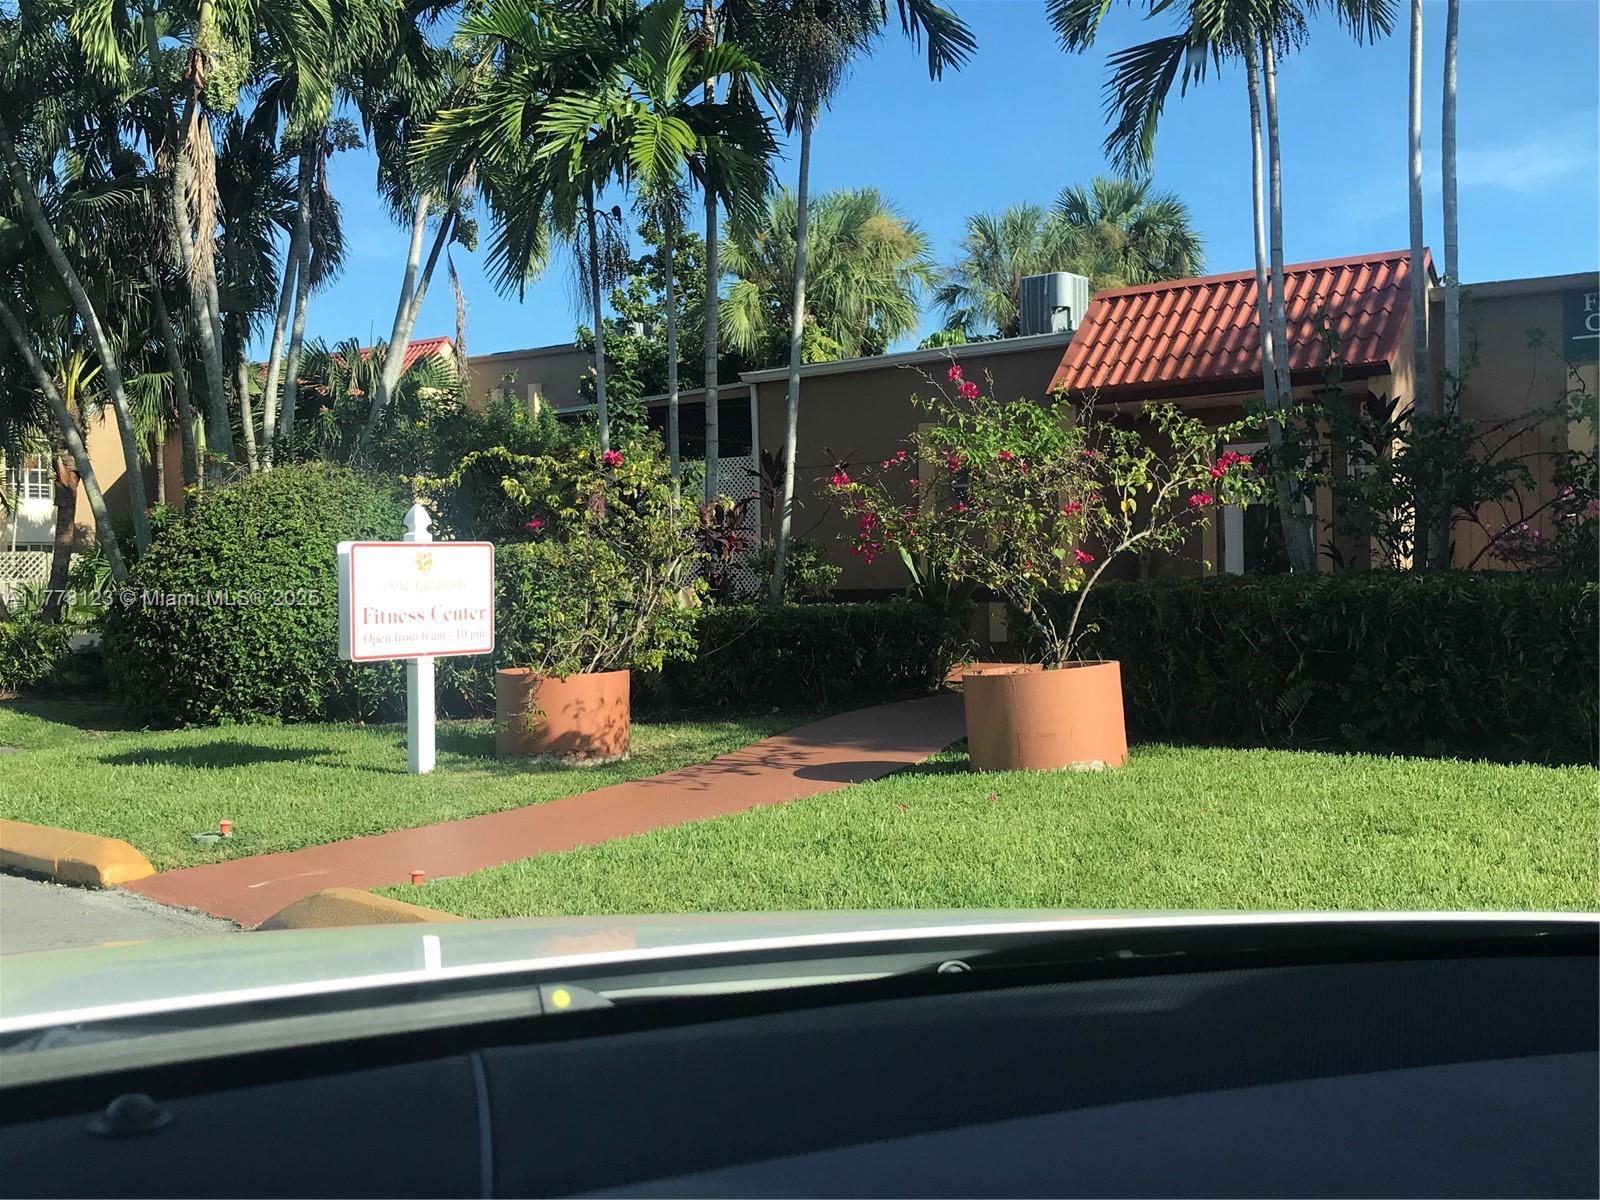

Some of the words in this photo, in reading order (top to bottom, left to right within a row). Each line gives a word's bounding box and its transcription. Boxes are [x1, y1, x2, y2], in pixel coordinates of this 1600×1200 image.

[363, 607, 425, 625] Fitness
[431, 604, 486, 622] Center
[363, 633, 391, 647] Open
[395, 631, 418, 643] from
[431, 632, 446, 641] am
[470, 630, 486, 642] pm
